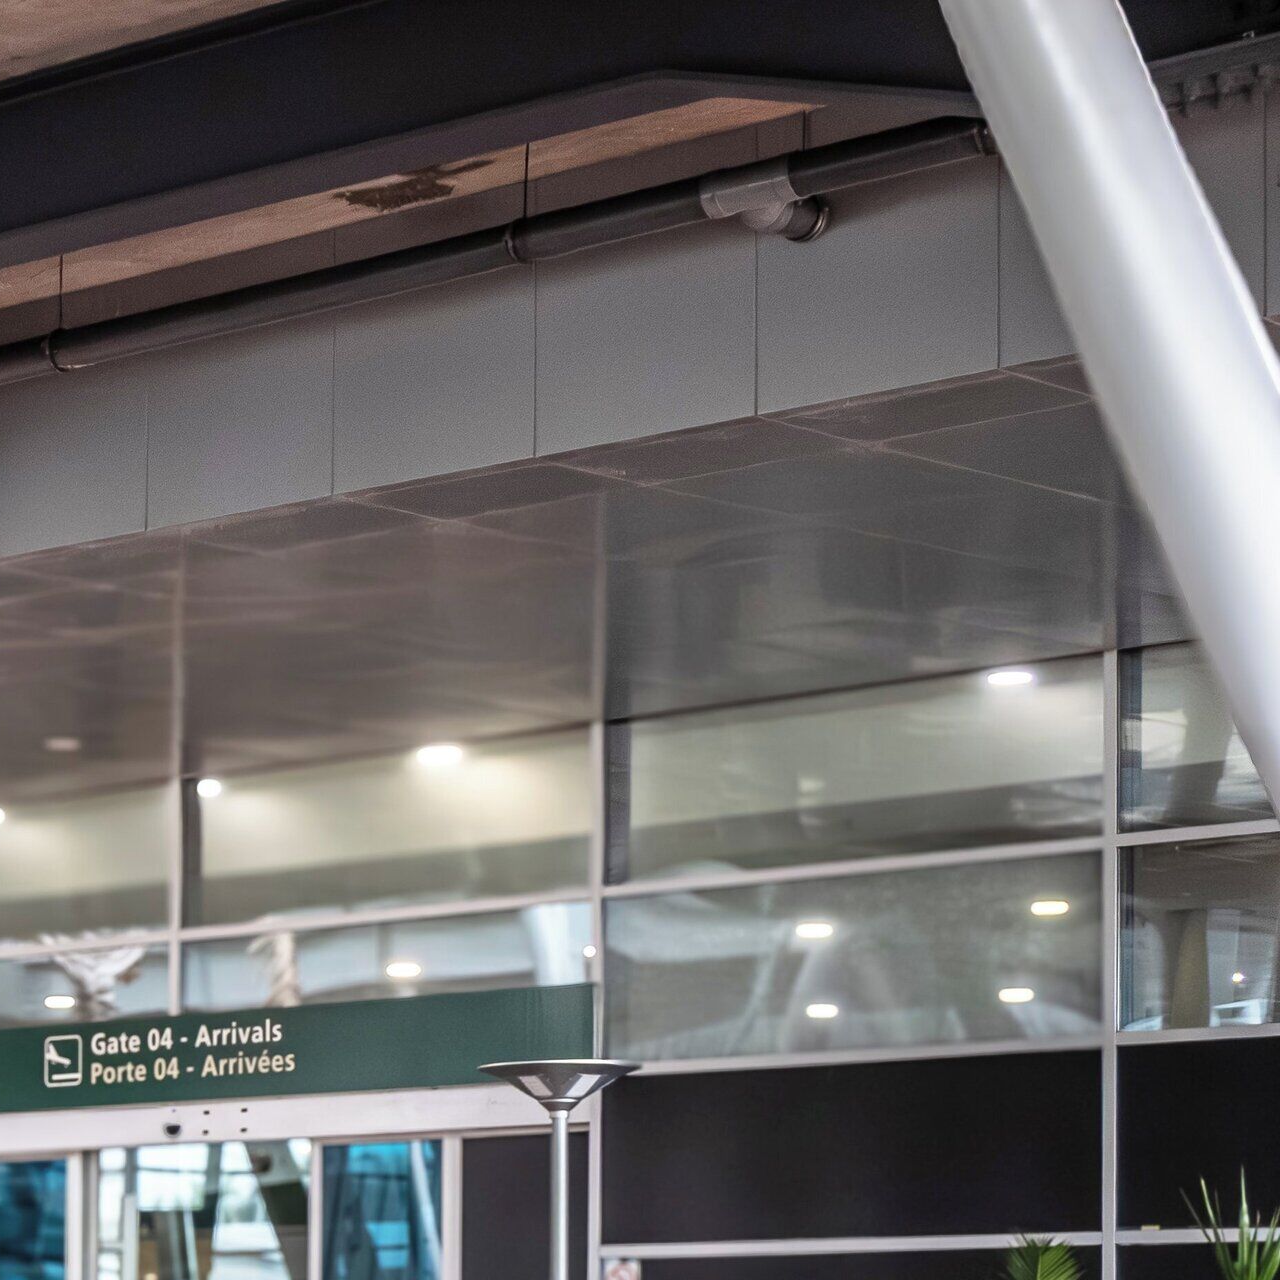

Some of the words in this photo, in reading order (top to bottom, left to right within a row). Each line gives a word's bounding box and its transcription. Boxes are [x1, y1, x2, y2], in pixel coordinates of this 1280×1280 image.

[90, 1032, 141, 1056] Gate
[147, 1027, 173, 1051] 04
[195, 1018, 282, 1048] Arrivals
[90, 1061, 147, 1085] Porte
[153, 1056, 180, 1081] 04
[201, 1049, 295, 1078] Arrivées
